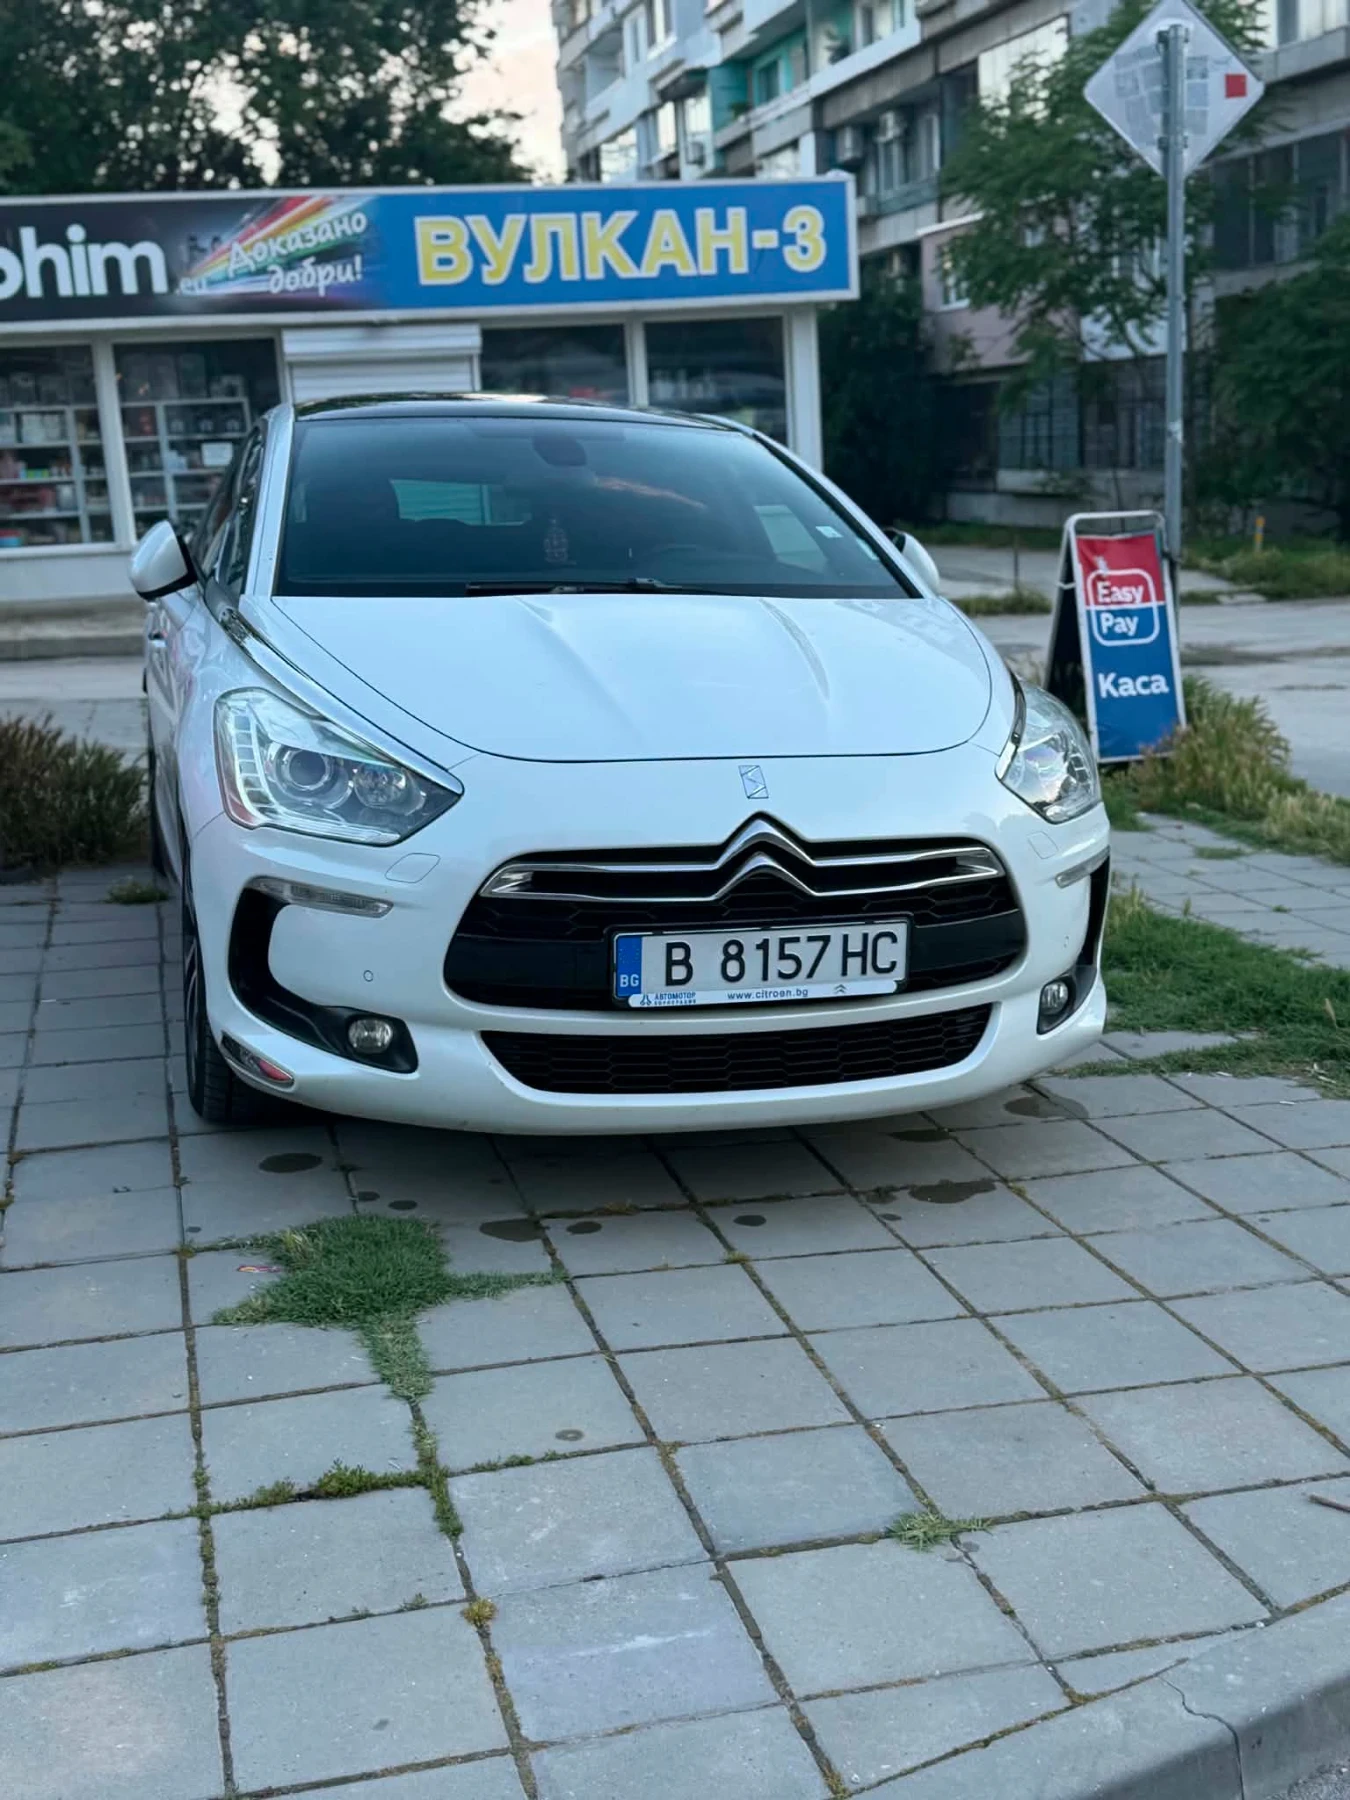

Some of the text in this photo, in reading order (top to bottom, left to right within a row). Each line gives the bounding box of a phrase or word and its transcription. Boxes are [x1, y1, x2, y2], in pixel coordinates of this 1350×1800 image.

[227, 211, 367, 277] Доказано
[414, 205, 827, 286] ВУЛКАН-3
[266, 254, 364, 297] добри!
[1096, 580, 1144, 605] Easy
[1099, 611, 1139, 636] Pay
[1097, 671, 1169, 699] Каса
[665, 931, 898, 987] B 8157 HC
[619, 974, 640, 988] BG
[727, 987, 809, 1000] www.citroen.bg
